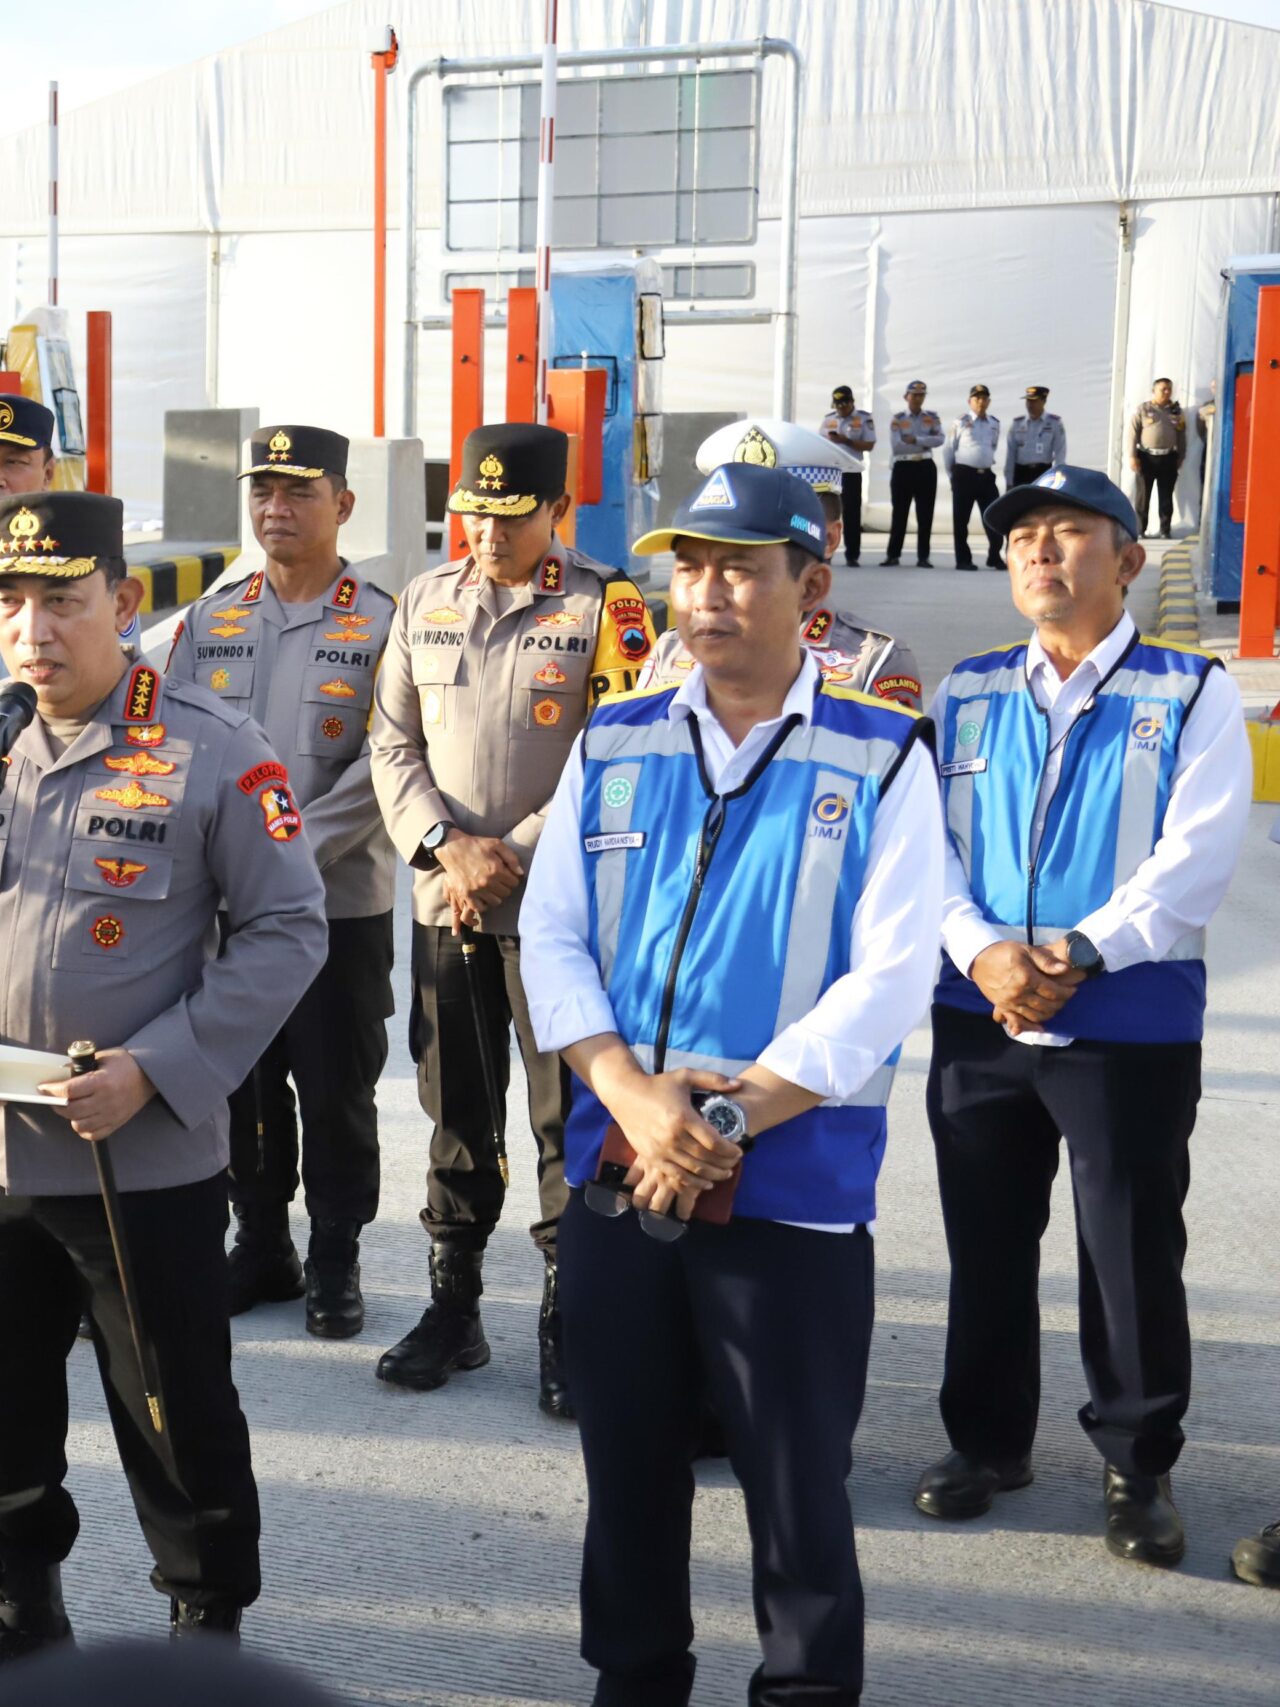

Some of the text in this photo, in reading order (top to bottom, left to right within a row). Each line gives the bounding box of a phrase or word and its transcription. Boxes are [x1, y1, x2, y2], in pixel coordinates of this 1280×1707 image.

[610, 600, 643, 611] POLDA
[423, 630, 465, 646] WIBOWO
[523, 636, 588, 653] POLRI
[197, 645, 254, 659] SUWONDO N
[314, 649, 370, 667] POLRI
[877, 678, 919, 693] KORLANTAS
[243, 764, 287, 788] PELOPO
[88, 815, 167, 844] POLRI
